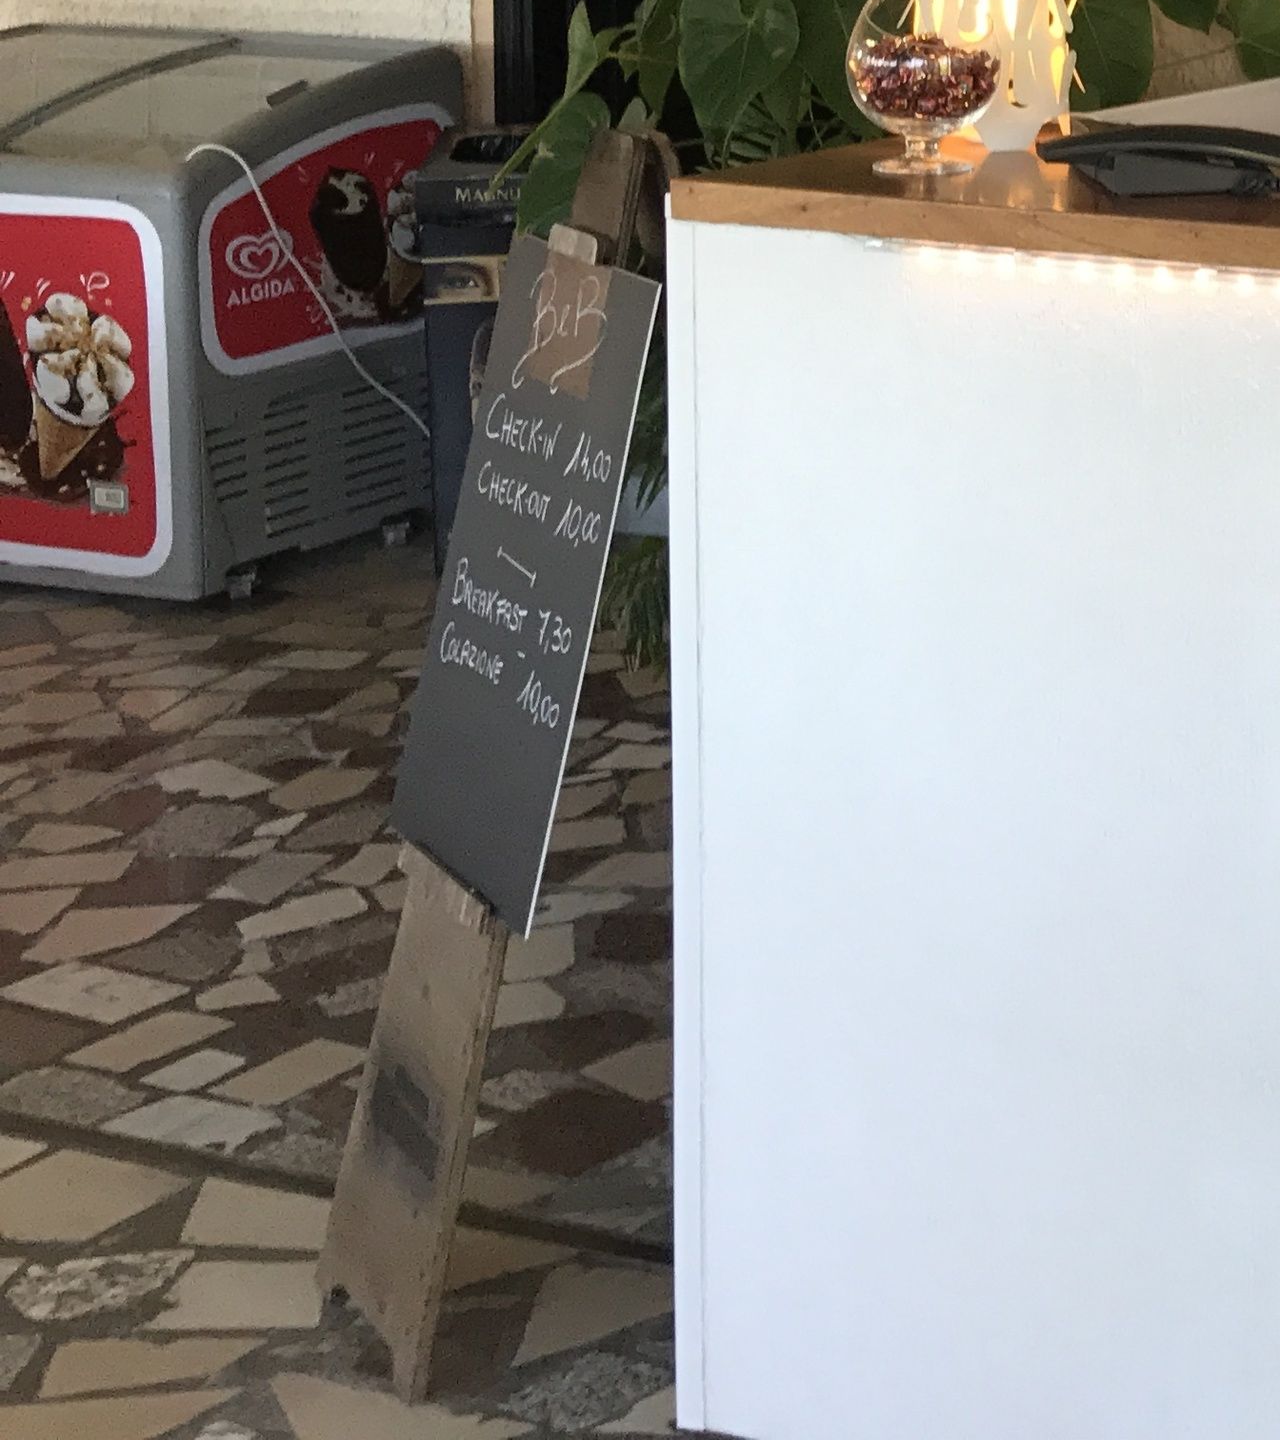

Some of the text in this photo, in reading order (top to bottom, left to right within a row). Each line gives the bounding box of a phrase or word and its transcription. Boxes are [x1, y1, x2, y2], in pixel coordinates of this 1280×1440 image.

[227, 278, 295, 310] ALGIDA
[485, 393, 612, 483] CHECK-IN 14,00
[477, 461, 601, 548] CHECK-OUT 10,00
[452, 558, 572, 654] BREAKFAST 7,30
[440, 621, 560, 728] COLAZIONE 10,00
